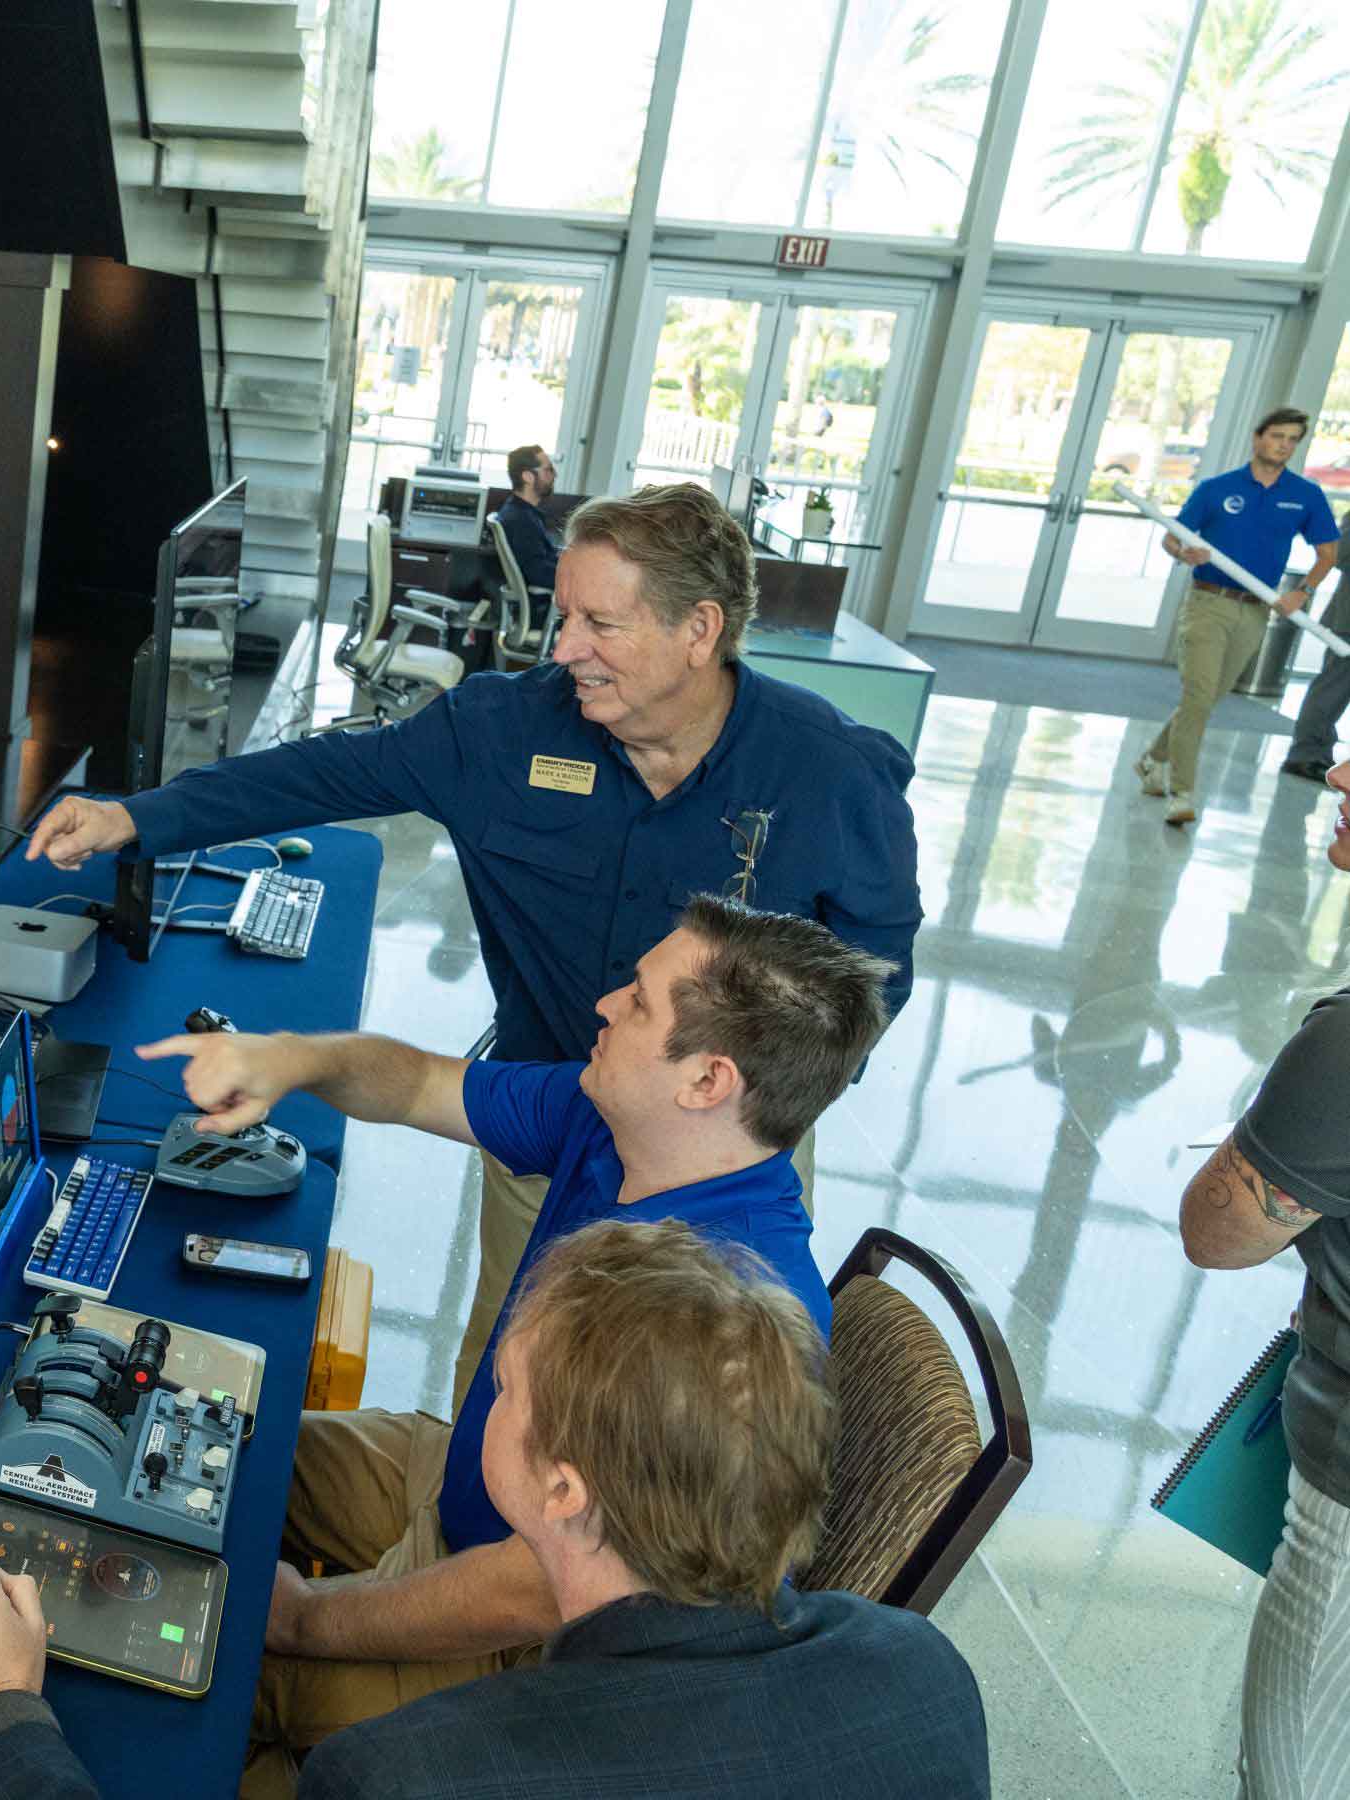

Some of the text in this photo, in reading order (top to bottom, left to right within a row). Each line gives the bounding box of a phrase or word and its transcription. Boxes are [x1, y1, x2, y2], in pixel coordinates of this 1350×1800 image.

[784, 237, 826, 265] EXIT
[3, 1469, 35, 1482] CENTER
[46, 1481, 95, 1499] AEROSPACE
[8, 1477, 89, 1504] RESILIENT SYSTEMS
